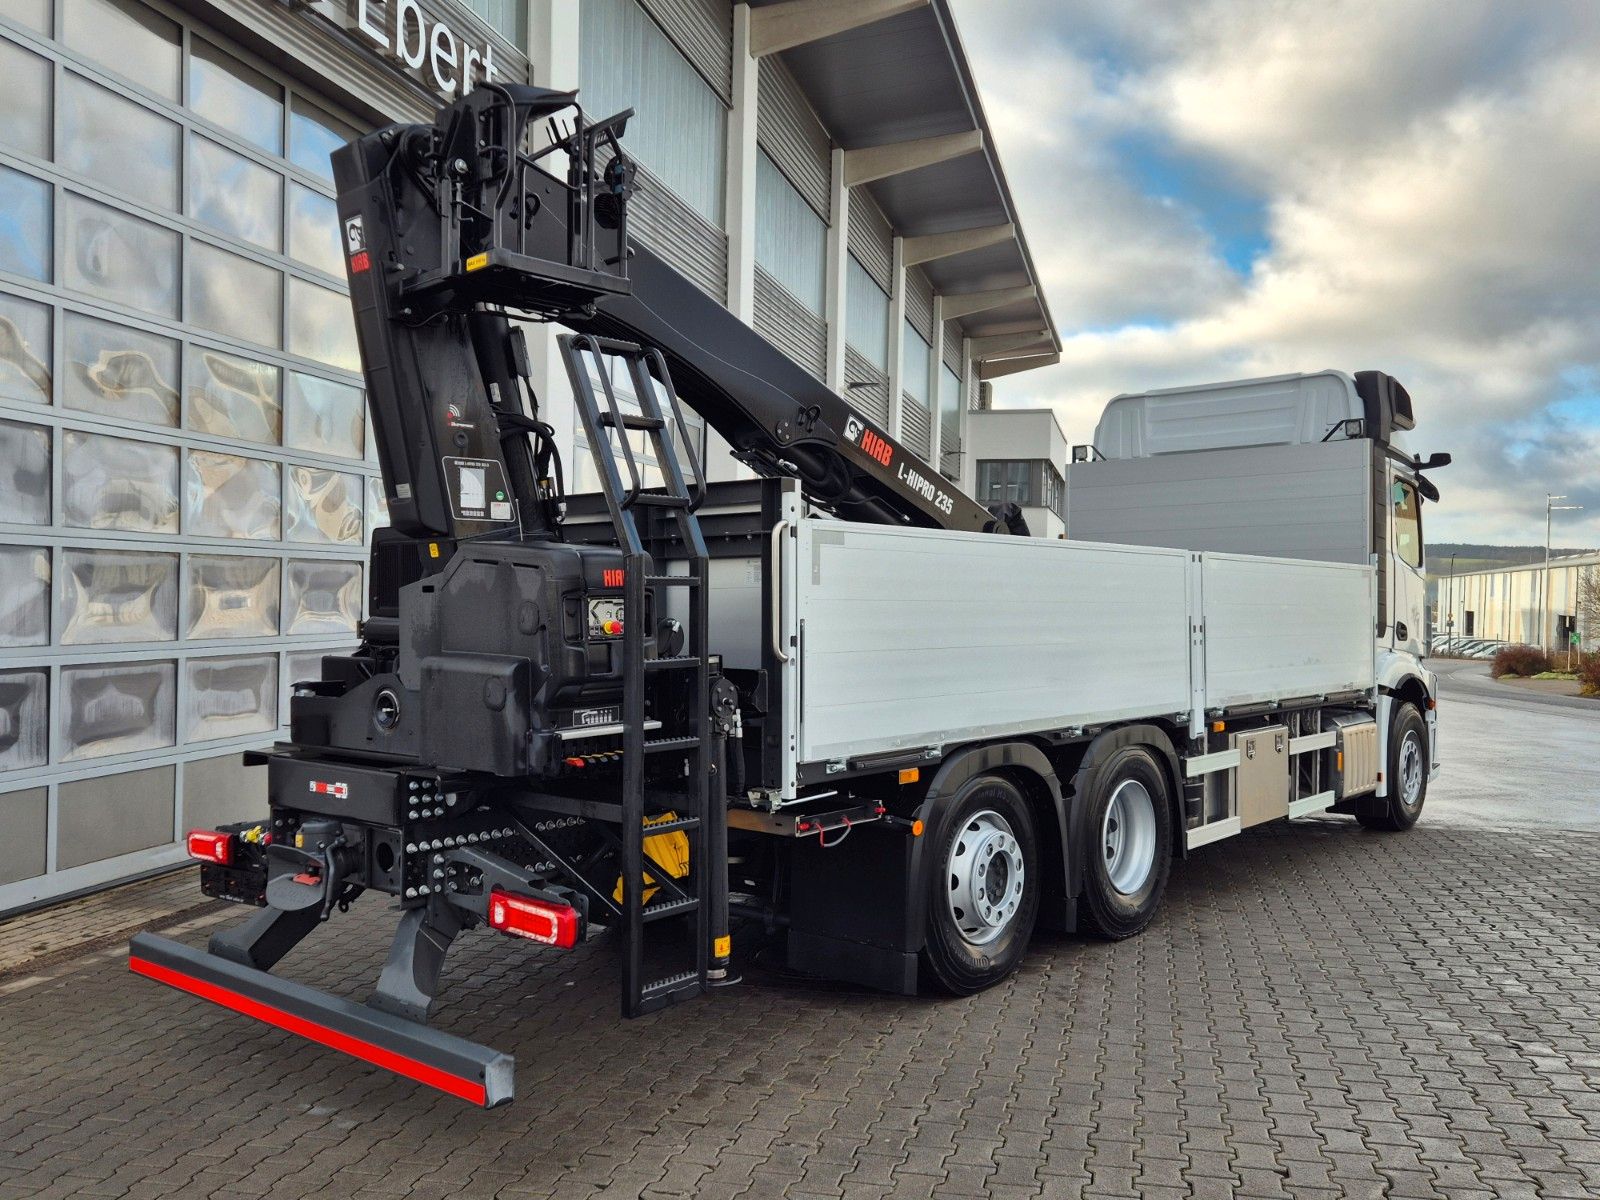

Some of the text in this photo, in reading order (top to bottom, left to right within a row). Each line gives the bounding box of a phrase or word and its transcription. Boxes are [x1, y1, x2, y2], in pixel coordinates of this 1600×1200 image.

[351, 251, 370, 273] HIAB
[861, 428, 954, 515] HIAB L-HIPRO 235
[603, 569, 625, 587] HIA
